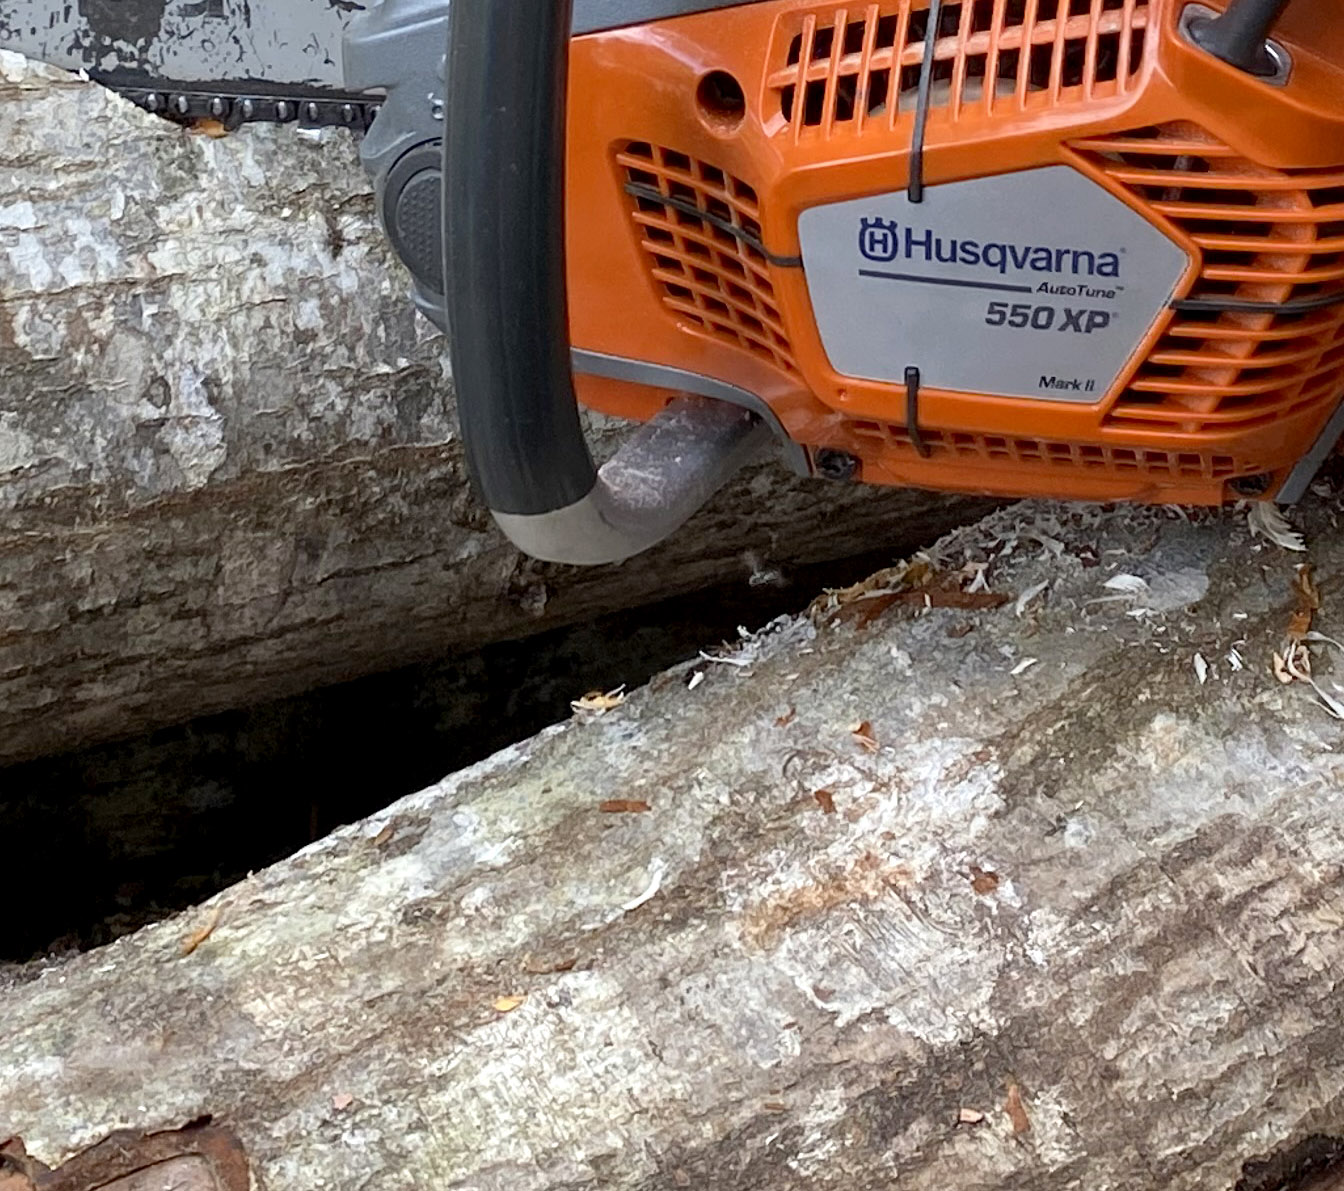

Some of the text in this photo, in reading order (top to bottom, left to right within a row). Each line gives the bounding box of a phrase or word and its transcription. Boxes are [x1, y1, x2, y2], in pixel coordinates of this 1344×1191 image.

[904, 227, 1121, 278] Husqvarna
[1036, 281, 1117, 299] AutoTune
[985, 301, 1111, 334] 550 XP
[1038, 376, 1082, 391] Mark
